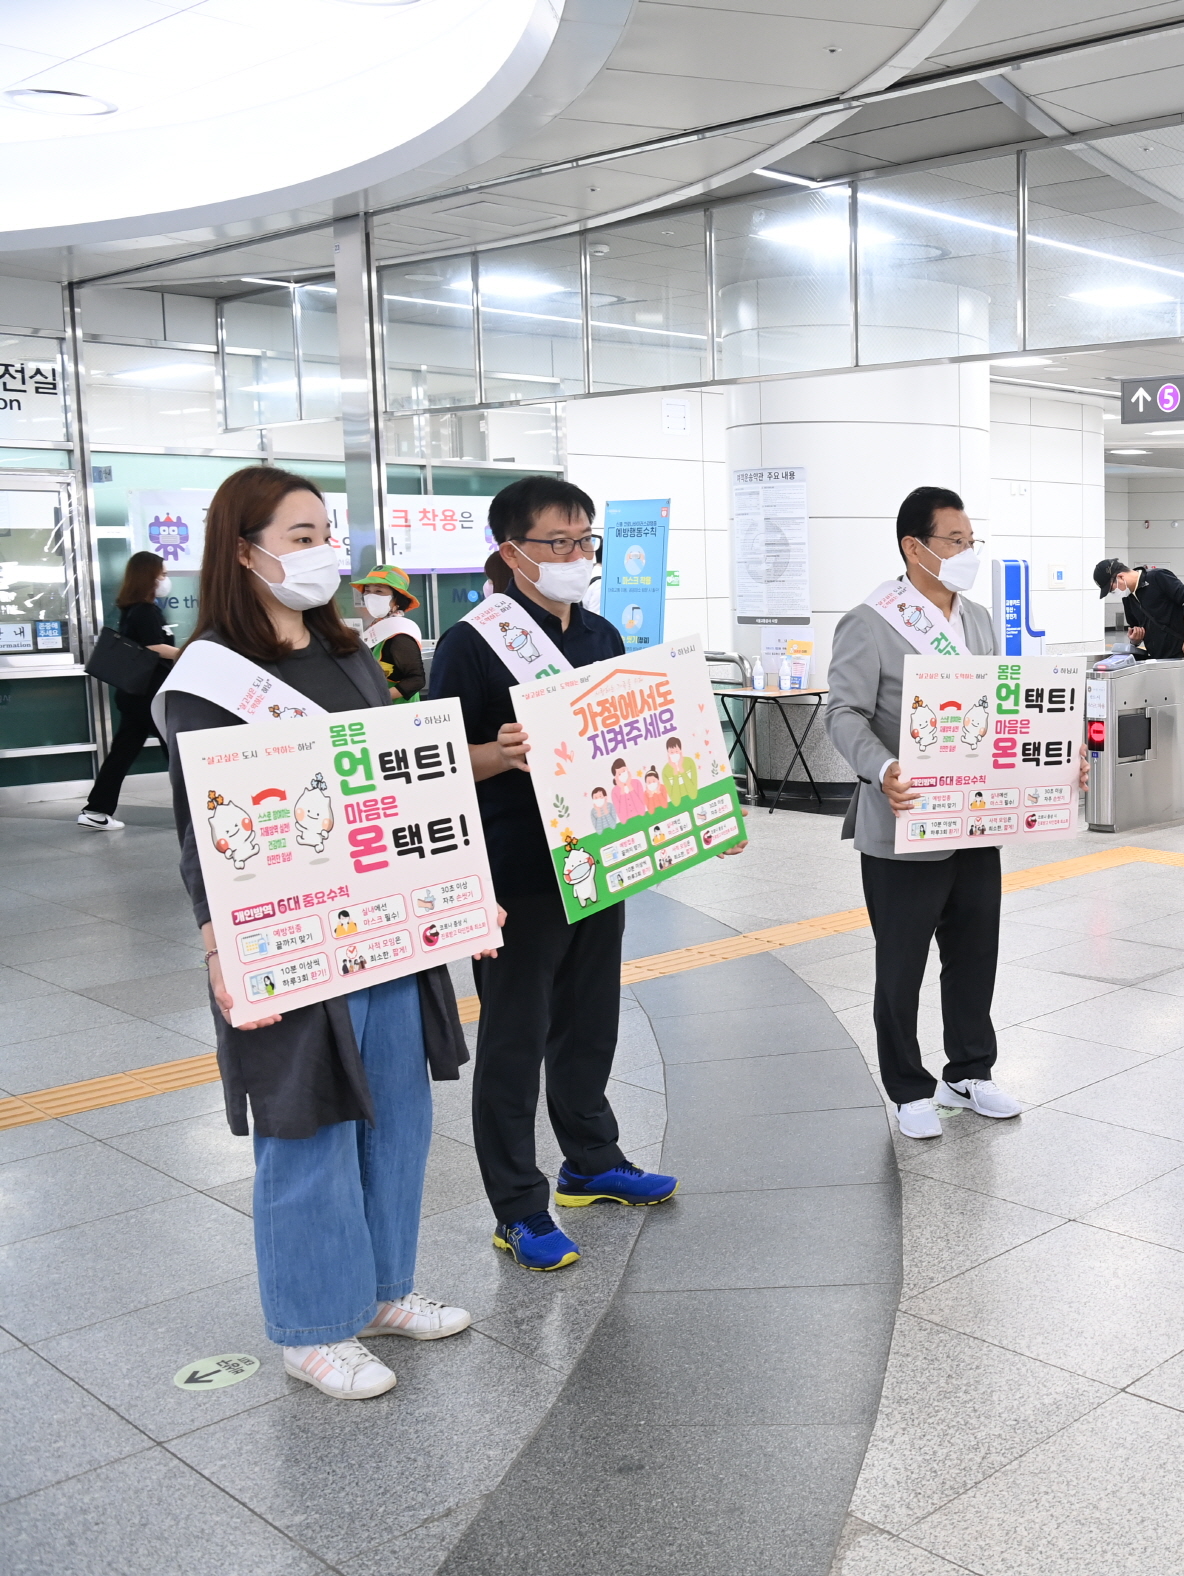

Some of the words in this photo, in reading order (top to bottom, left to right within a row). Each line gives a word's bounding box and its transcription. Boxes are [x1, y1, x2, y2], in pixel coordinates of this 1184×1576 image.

[767, 472, 780, 480] 주요
[782, 470, 796, 480] 내용
[418, 508, 474, 532] 착용은
[616, 527, 657, 538] 예방행동수칙
[678, 645, 696, 656] 하남시
[940, 672, 950, 680] 도시
[998, 664, 1022, 680] 몸은
[252, 676, 264, 689] 도시
[546, 686, 557, 694] 도시
[572, 680, 676, 738] 가정에서도
[330, 722, 366, 748] 몸은
[424, 714, 450, 724] 하남시
[586, 708, 678, 760] 지켜주세요
[995, 719, 1030, 735] 마음은
[242, 750, 258, 760] 도시
[265, 745, 296, 756] 도약하는
[334, 742, 457, 796] 언택트!
[939, 776, 954, 786] 6대
[955, 775, 986, 786] 중요수칙
[344, 796, 398, 824] 마음은
[348, 814, 470, 874] 온택트!
[441, 884, 455, 894] 30초
[456, 881, 468, 890] 이상
[234, 904, 274, 924] 개인방역
[277, 896, 301, 914] 6대
[302, 885, 350, 908] 중요수칙
[442, 896, 454, 904] 자주
[456, 892, 474, 902] 손씻기
[362, 903, 388, 917] 실내에선
[364, 916, 384, 926] 마스크
[384, 910, 400, 922] 필수!
[272, 924, 302, 938] 예방접종
[440, 922, 452, 930] 코로나
[275, 938, 297, 950] 끝까지
[368, 942, 380, 950] 사적
[382, 936, 402, 948] 모임은
[280, 965, 297, 976] 10분
[299, 958, 320, 970] 이상씩
[282, 974, 309, 986] 하루3회
[310, 969, 327, 980] 환기!
[216, 1360, 245, 1375] 비상구
[237, 1356, 255, 1366] EXIT
